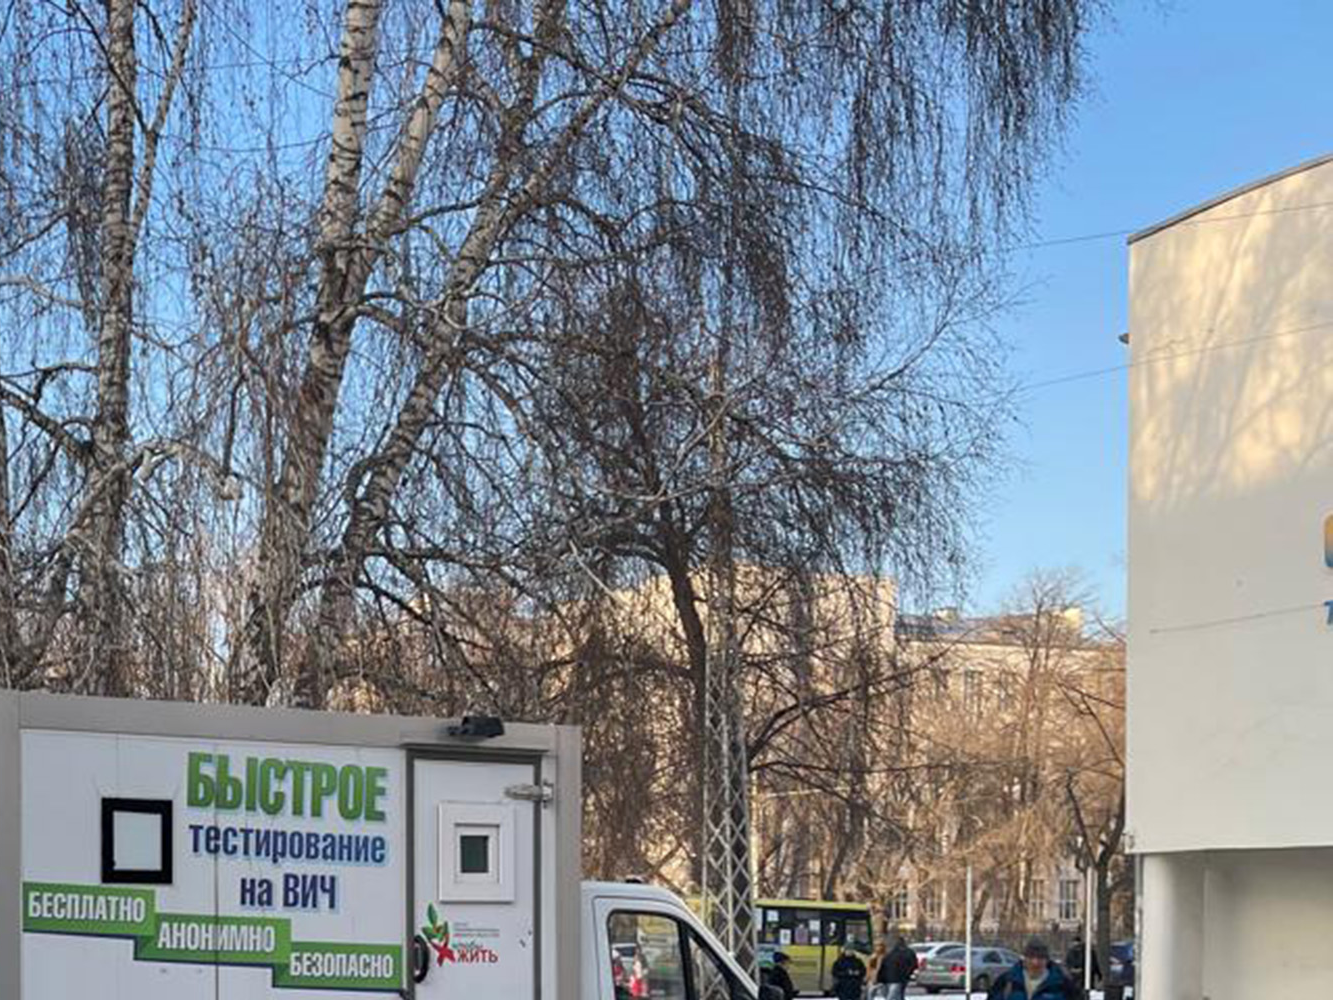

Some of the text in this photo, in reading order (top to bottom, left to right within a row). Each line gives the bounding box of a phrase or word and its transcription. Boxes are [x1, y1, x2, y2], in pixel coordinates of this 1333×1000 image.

[186, 751, 388, 822] БЫСТРОЕ
[188, 824, 387, 864] тестирование
[27, 891, 147, 923] БЕСПЛАТНО
[239, 872, 337, 910] на ВИЧ
[157, 921, 276, 953] АНОНИМНО
[289, 951, 394, 979] БЕЗОПАСНО
[457, 948, 499, 964] ЖИТЬ
